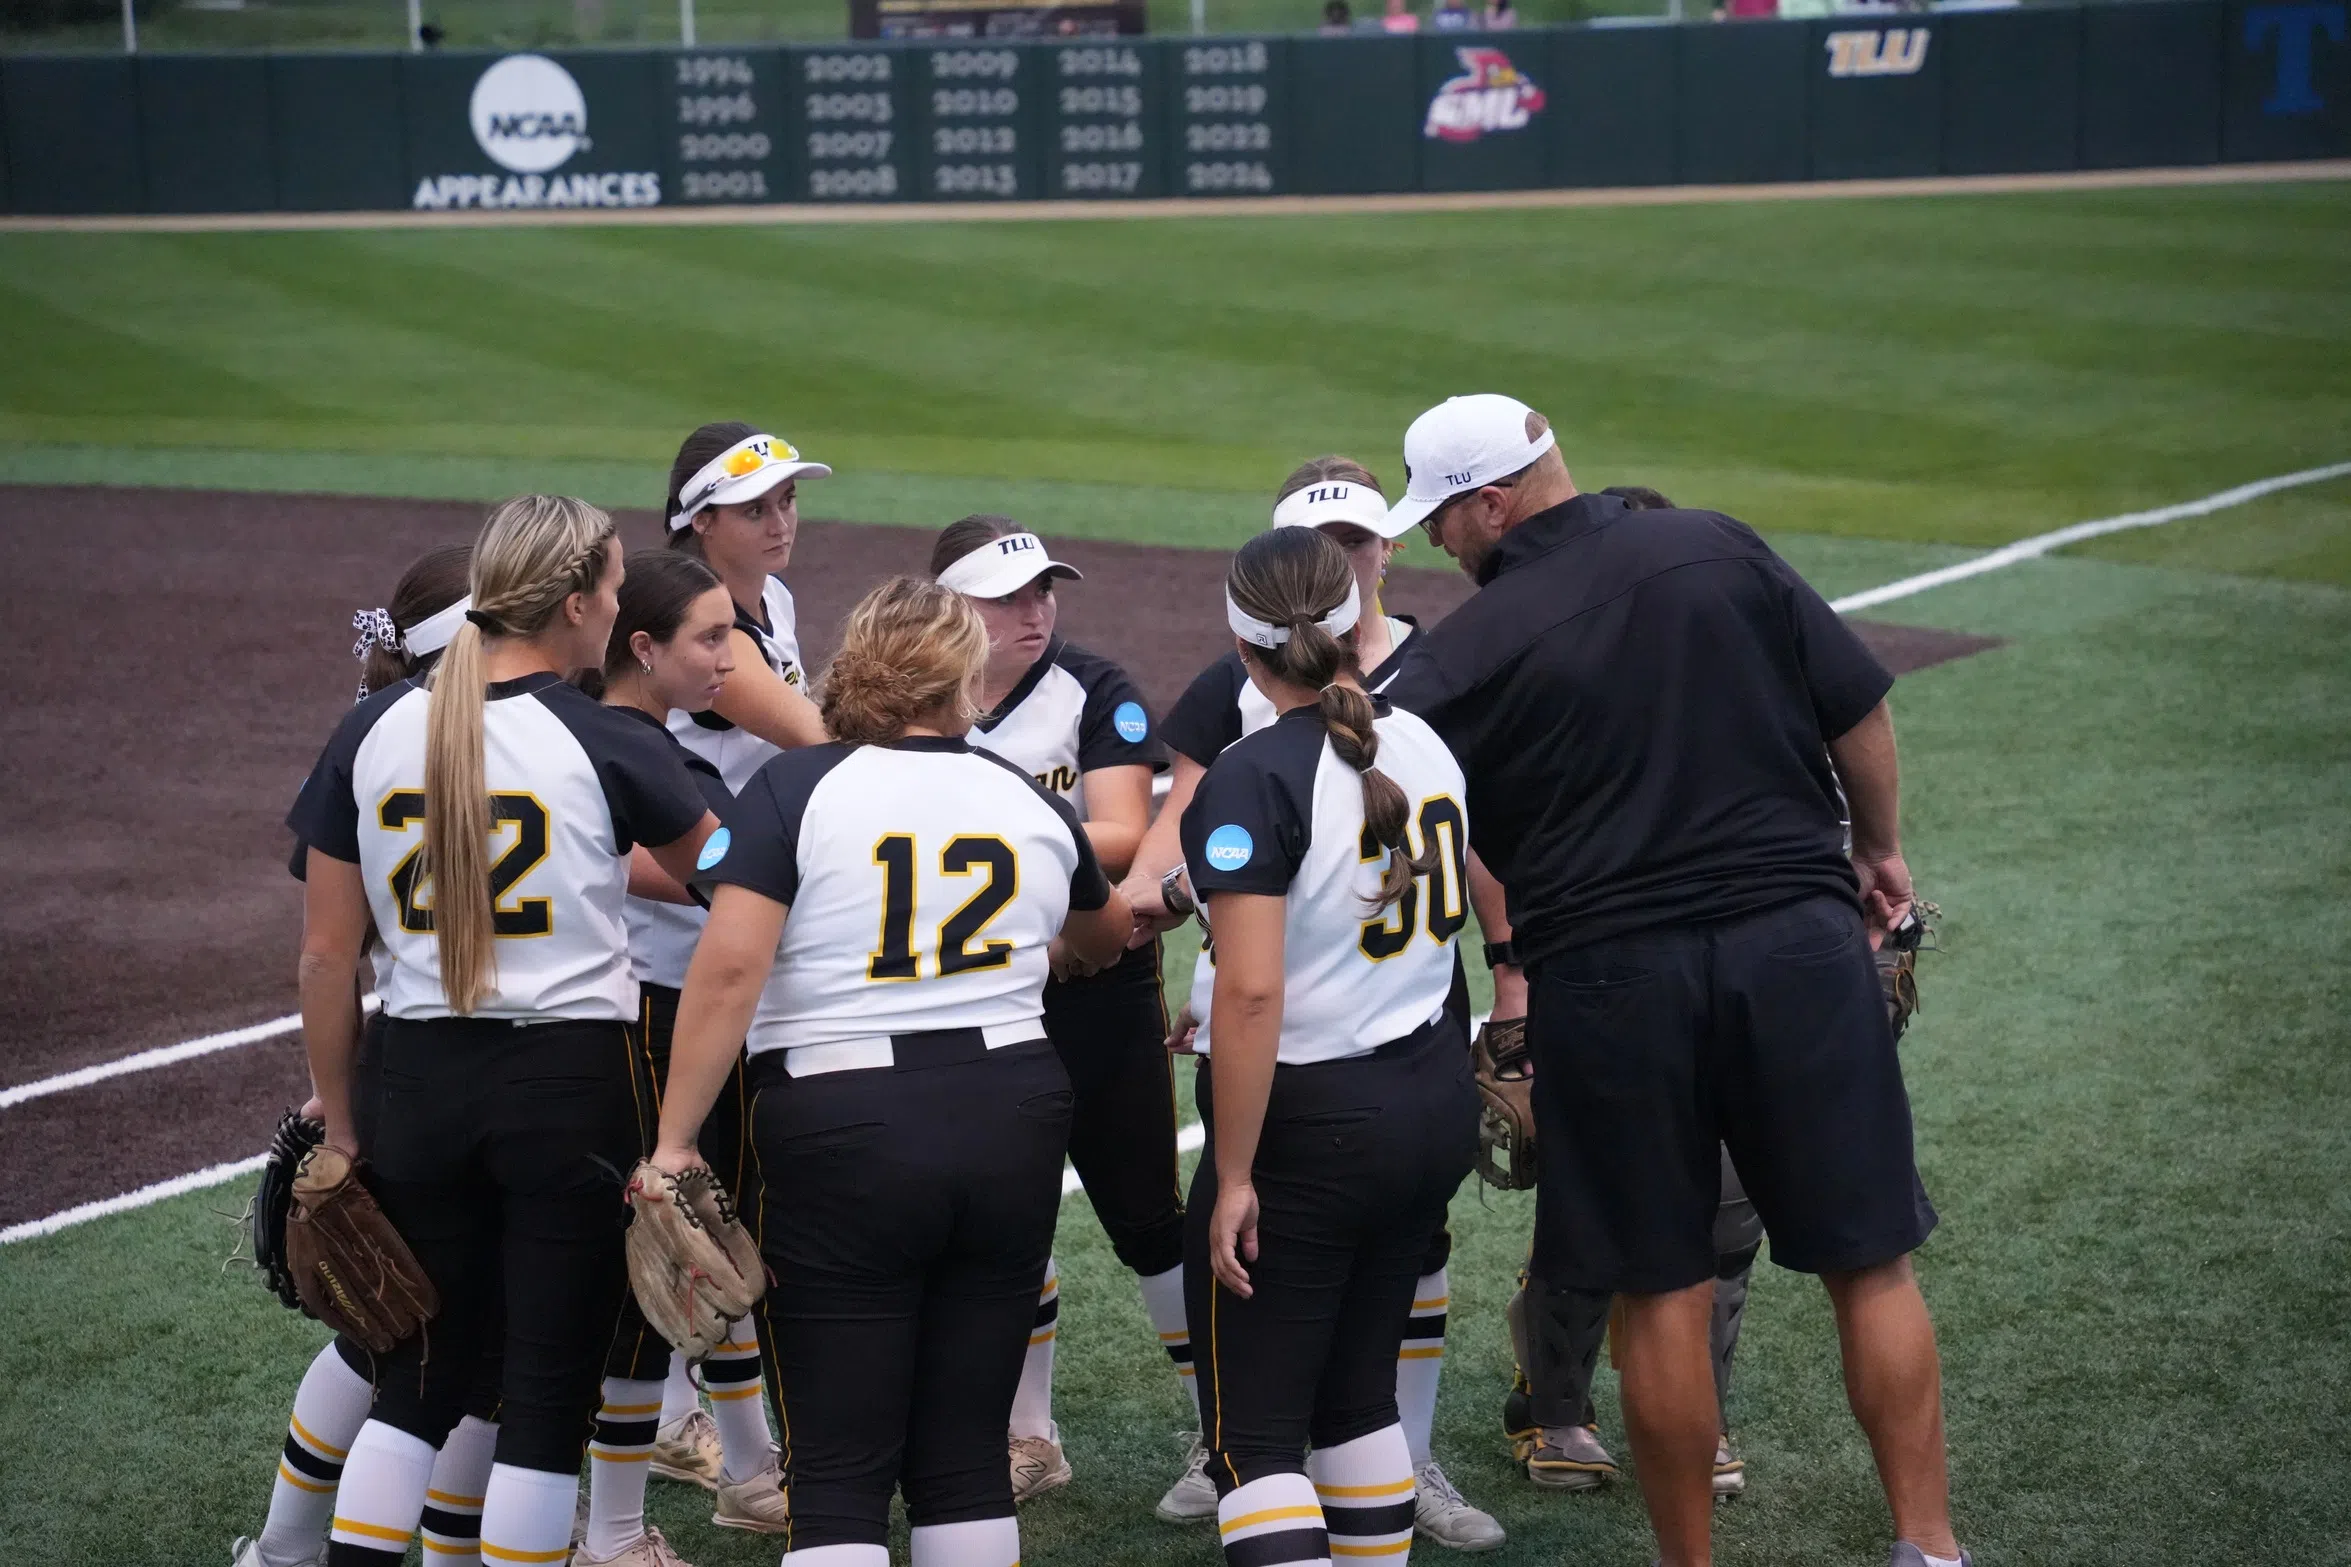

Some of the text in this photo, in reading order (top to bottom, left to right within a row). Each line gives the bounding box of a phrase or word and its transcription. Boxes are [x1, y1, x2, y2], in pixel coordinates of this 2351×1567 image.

[930, 50, 1019, 80] 2009
[1057, 48, 1142, 76] 2014
[1825, 28, 1932, 78] TLU
[676, 56, 754, 86] 1994
[677, 88, 756, 125] 1996
[932, 88, 1018, 116] 2010
[1059, 86, 1142, 117] 2015
[488, 112, 579, 140] NCAA
[1060, 119, 1143, 152] 2016
[679, 132, 771, 161] 2000
[807, 130, 894, 162] 2007
[413, 171, 661, 209] APPEARANCES
[681, 170, 768, 199] 2001
[809, 165, 897, 196] 2008
[1061, 162, 1143, 193] 2017
[1186, 161, 1273, 192] 2024
[1445, 472, 1472, 486] TLU
[1307, 486, 1348, 504] TLU
[998, 537, 1035, 555] TLU
[1119, 720, 1147, 733] NCAA
[1210, 846, 1250, 860] NCAA
[866, 832, 1020, 982] 12
